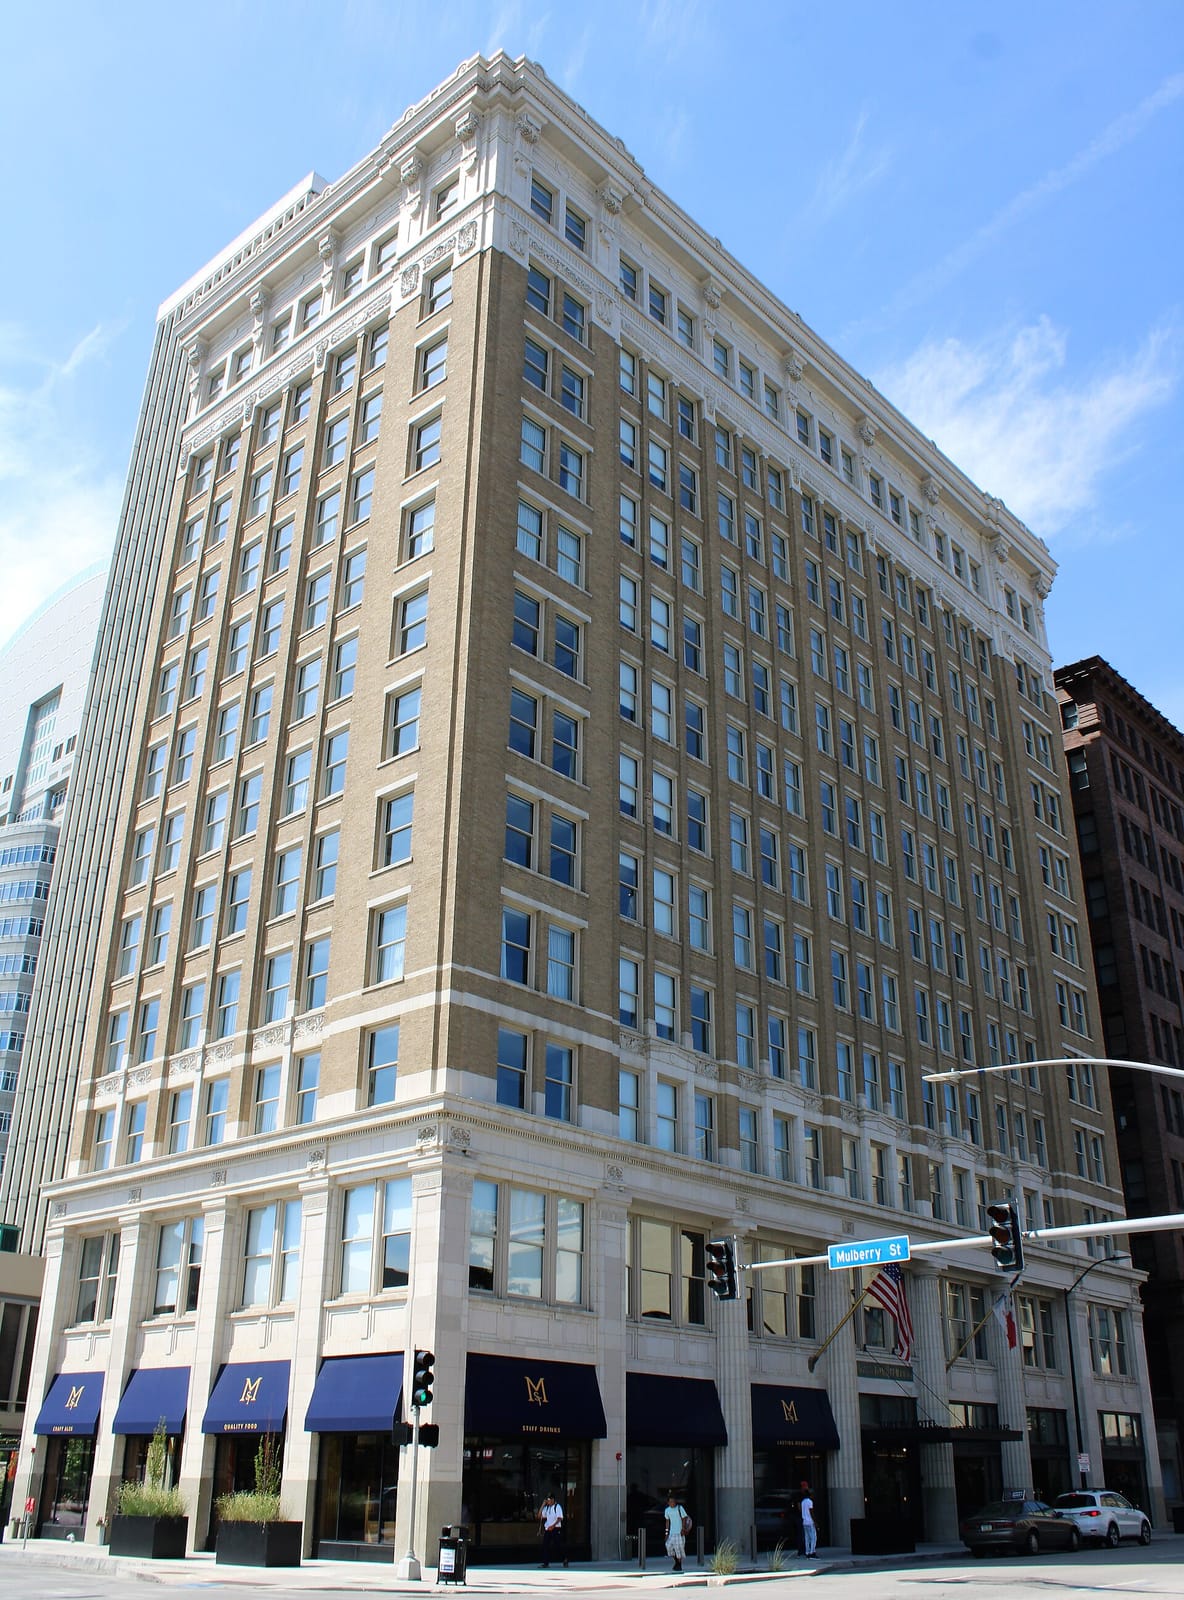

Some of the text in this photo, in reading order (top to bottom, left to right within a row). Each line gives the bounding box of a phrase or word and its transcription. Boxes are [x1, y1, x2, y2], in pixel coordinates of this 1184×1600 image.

[836, 1243, 902, 1263] Mulberry St
[522, 1424, 561, 1433] STIFF DRINKS
